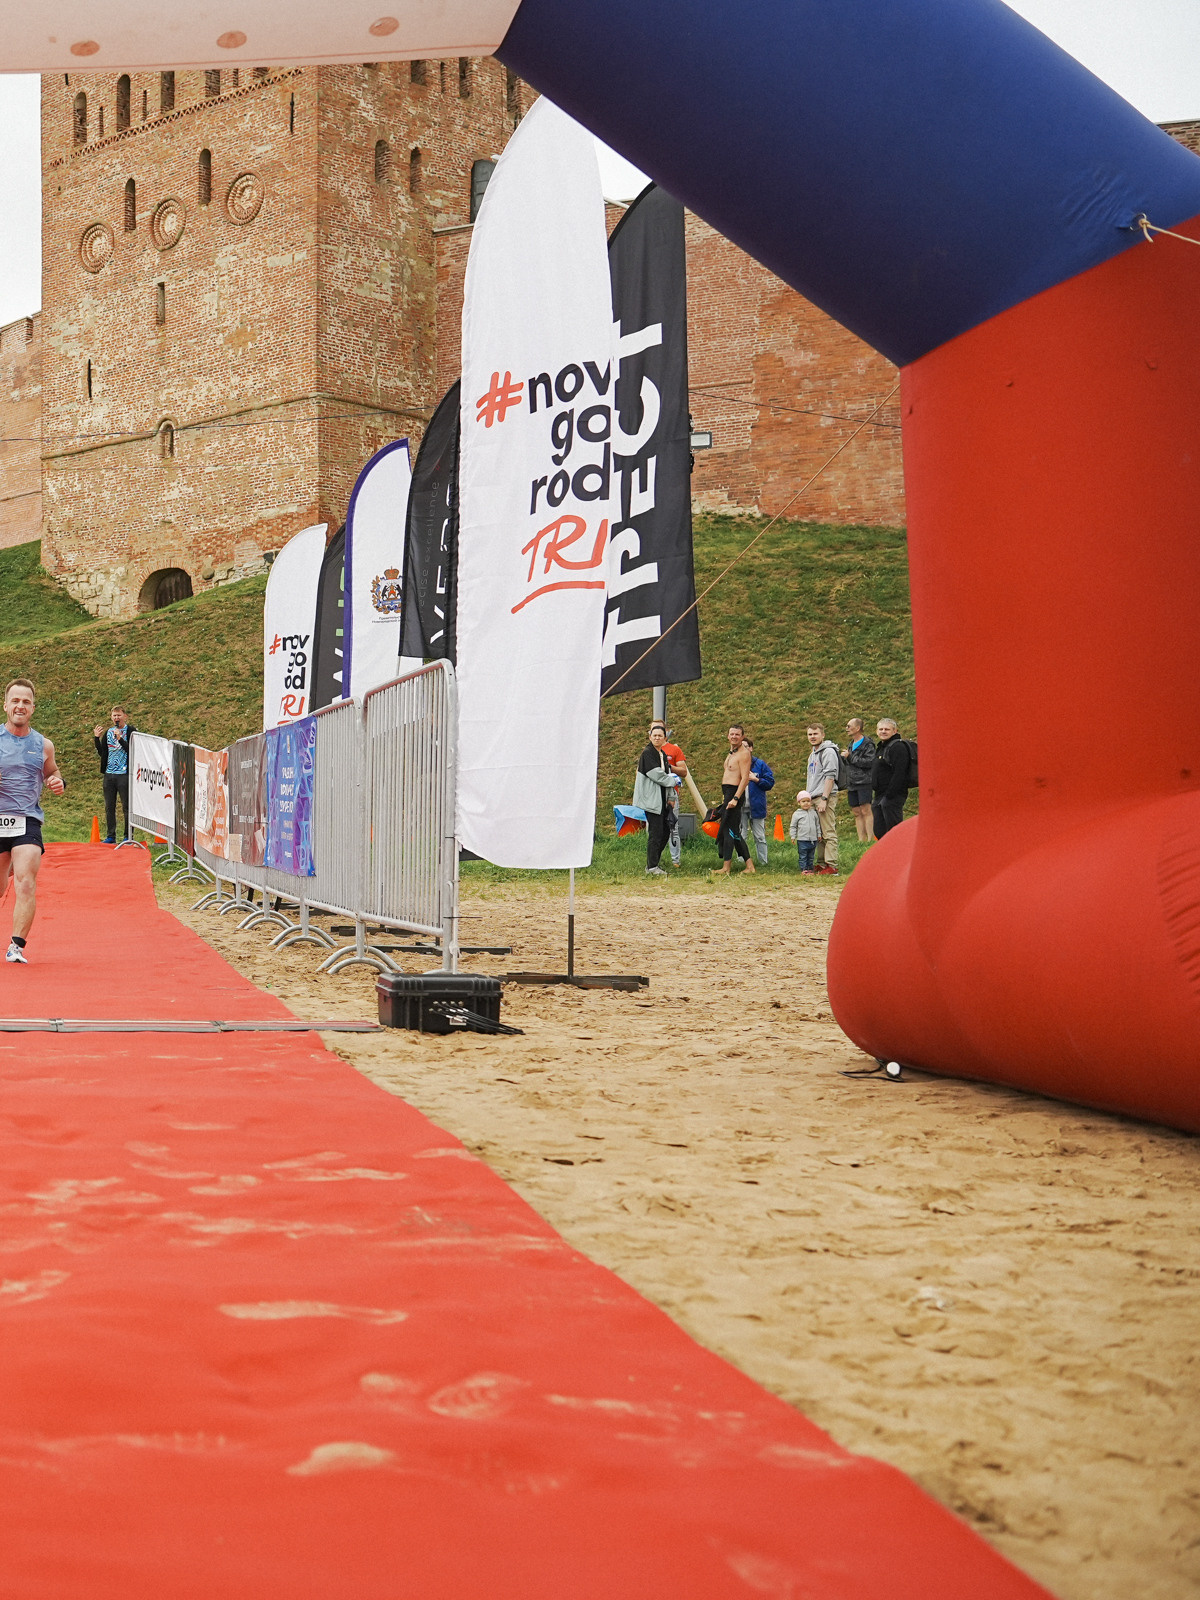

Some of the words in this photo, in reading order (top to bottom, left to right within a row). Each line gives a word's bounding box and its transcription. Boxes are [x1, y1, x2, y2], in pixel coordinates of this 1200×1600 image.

[476, 360, 612, 429] #nov
[551, 404, 612, 467] go
[529, 441, 611, 516] rod
[600, 318, 663, 670] ТРЕСТ
[521, 514, 609, 583] TRI
[0, 817, 17, 827] 109
